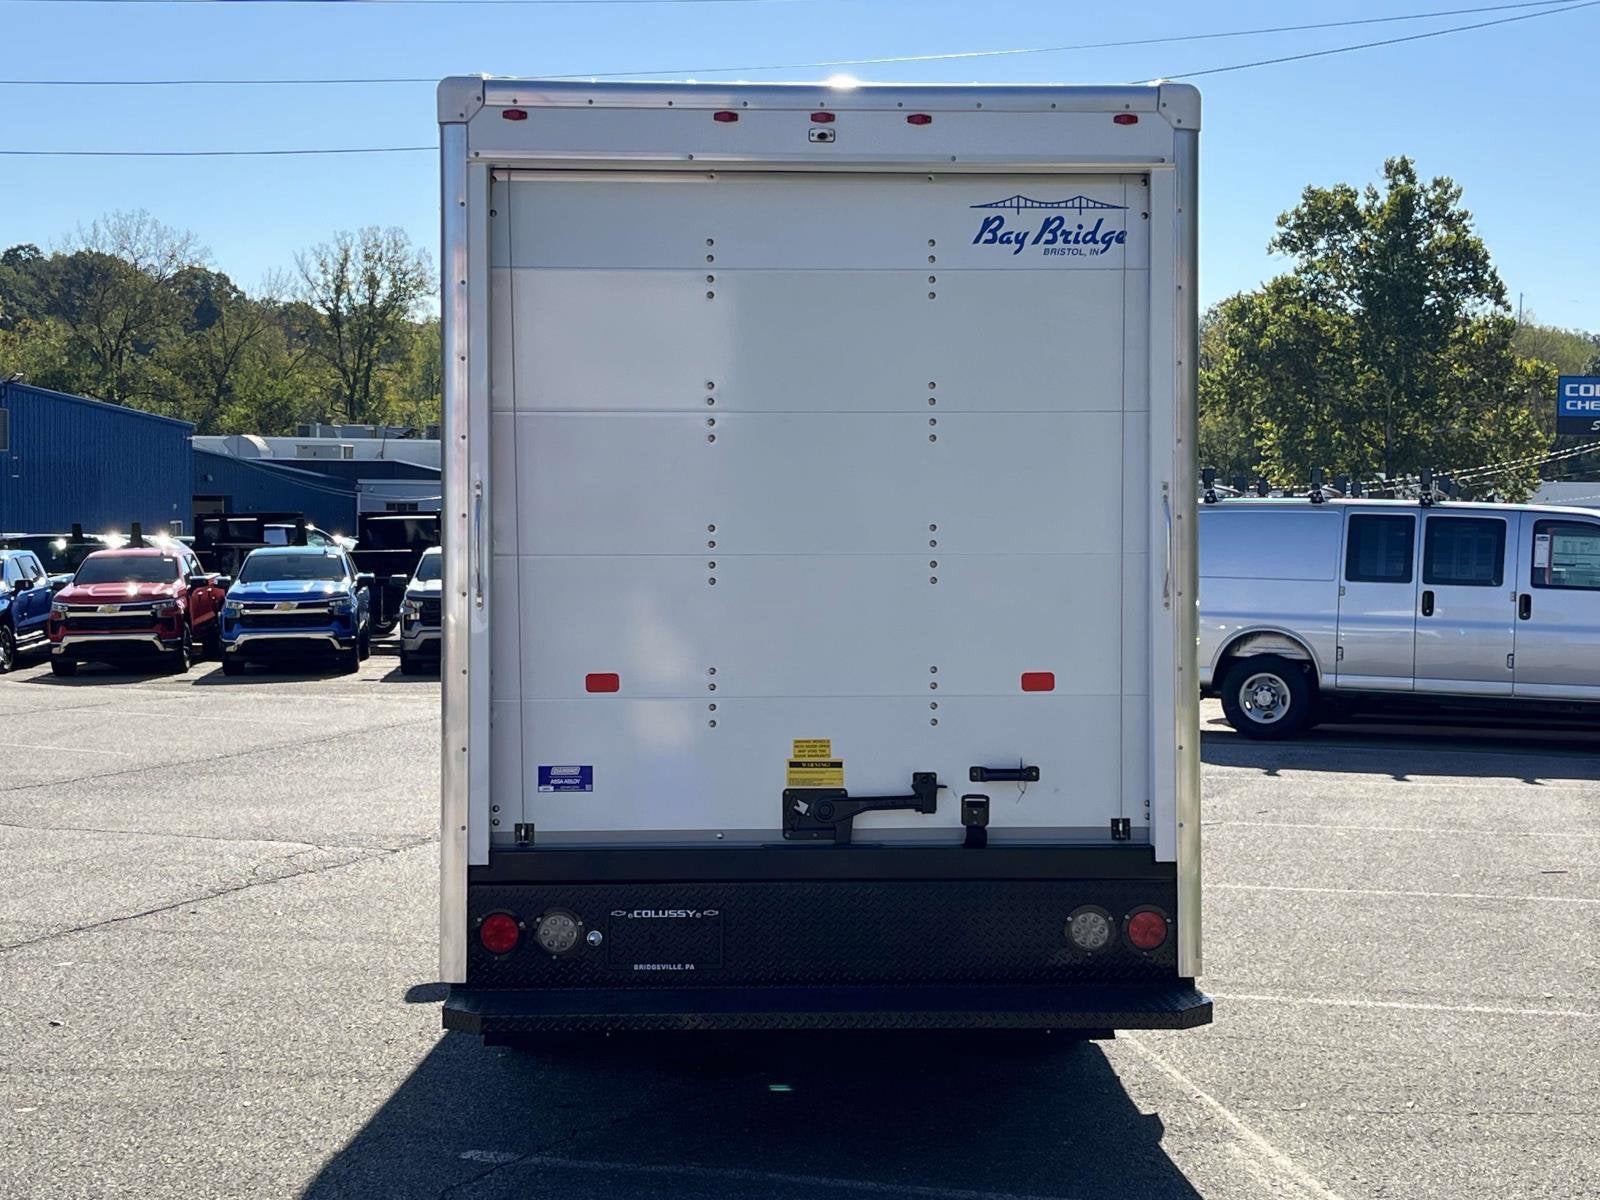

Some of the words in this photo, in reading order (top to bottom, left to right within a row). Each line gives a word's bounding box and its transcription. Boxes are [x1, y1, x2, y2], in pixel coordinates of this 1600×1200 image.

[972, 215, 1031, 255] Bay
[1031, 216, 1128, 255] Bridge
[1043, 248, 1087, 257] BRISTOL,
[1089, 248, 1100, 256] IN
[633, 910, 697, 918] COLUSSY
